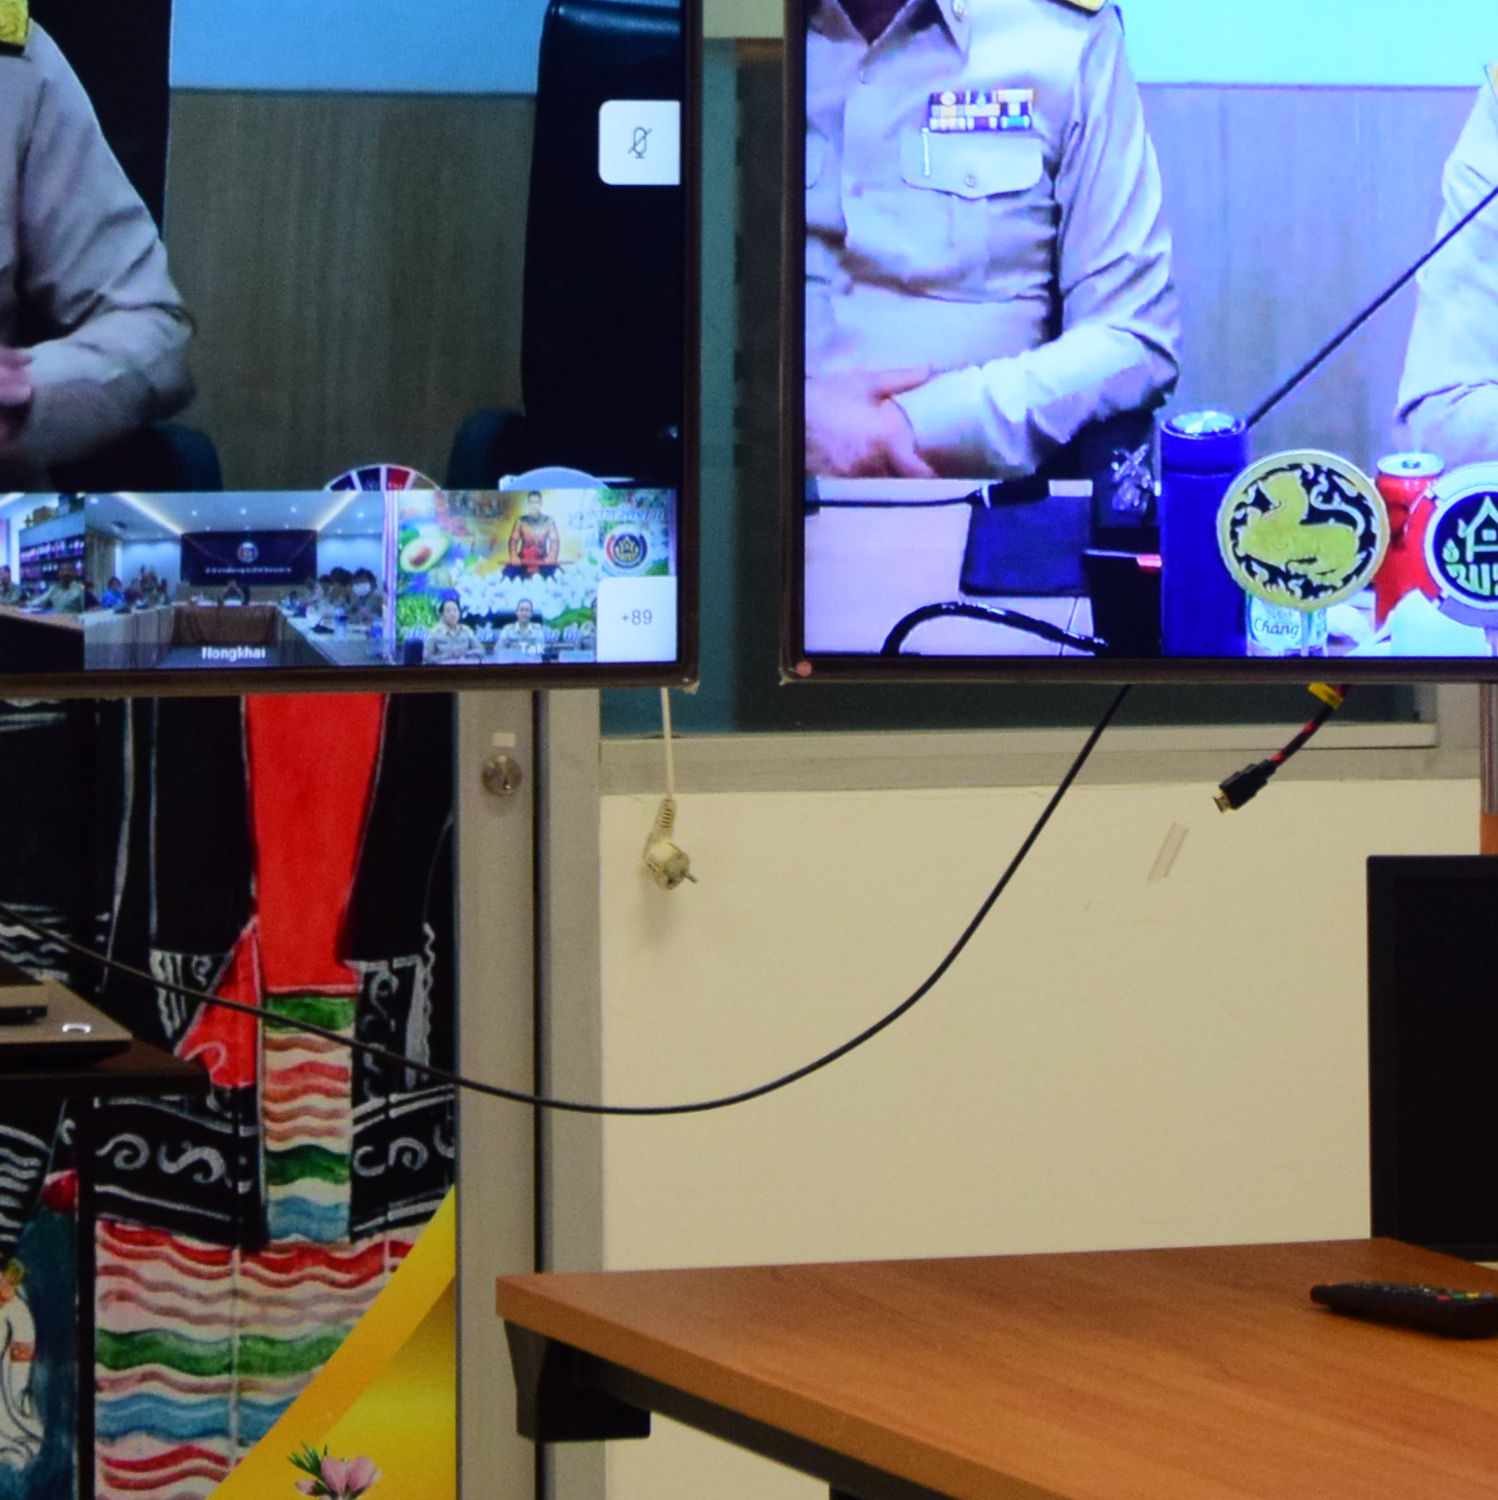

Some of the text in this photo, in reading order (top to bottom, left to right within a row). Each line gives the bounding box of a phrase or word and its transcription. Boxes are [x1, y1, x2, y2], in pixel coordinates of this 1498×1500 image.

[620, 606, 654, 628] +89
[1253, 616, 1301, 640] Chang
[201, 646, 266, 662] Nongkhai
